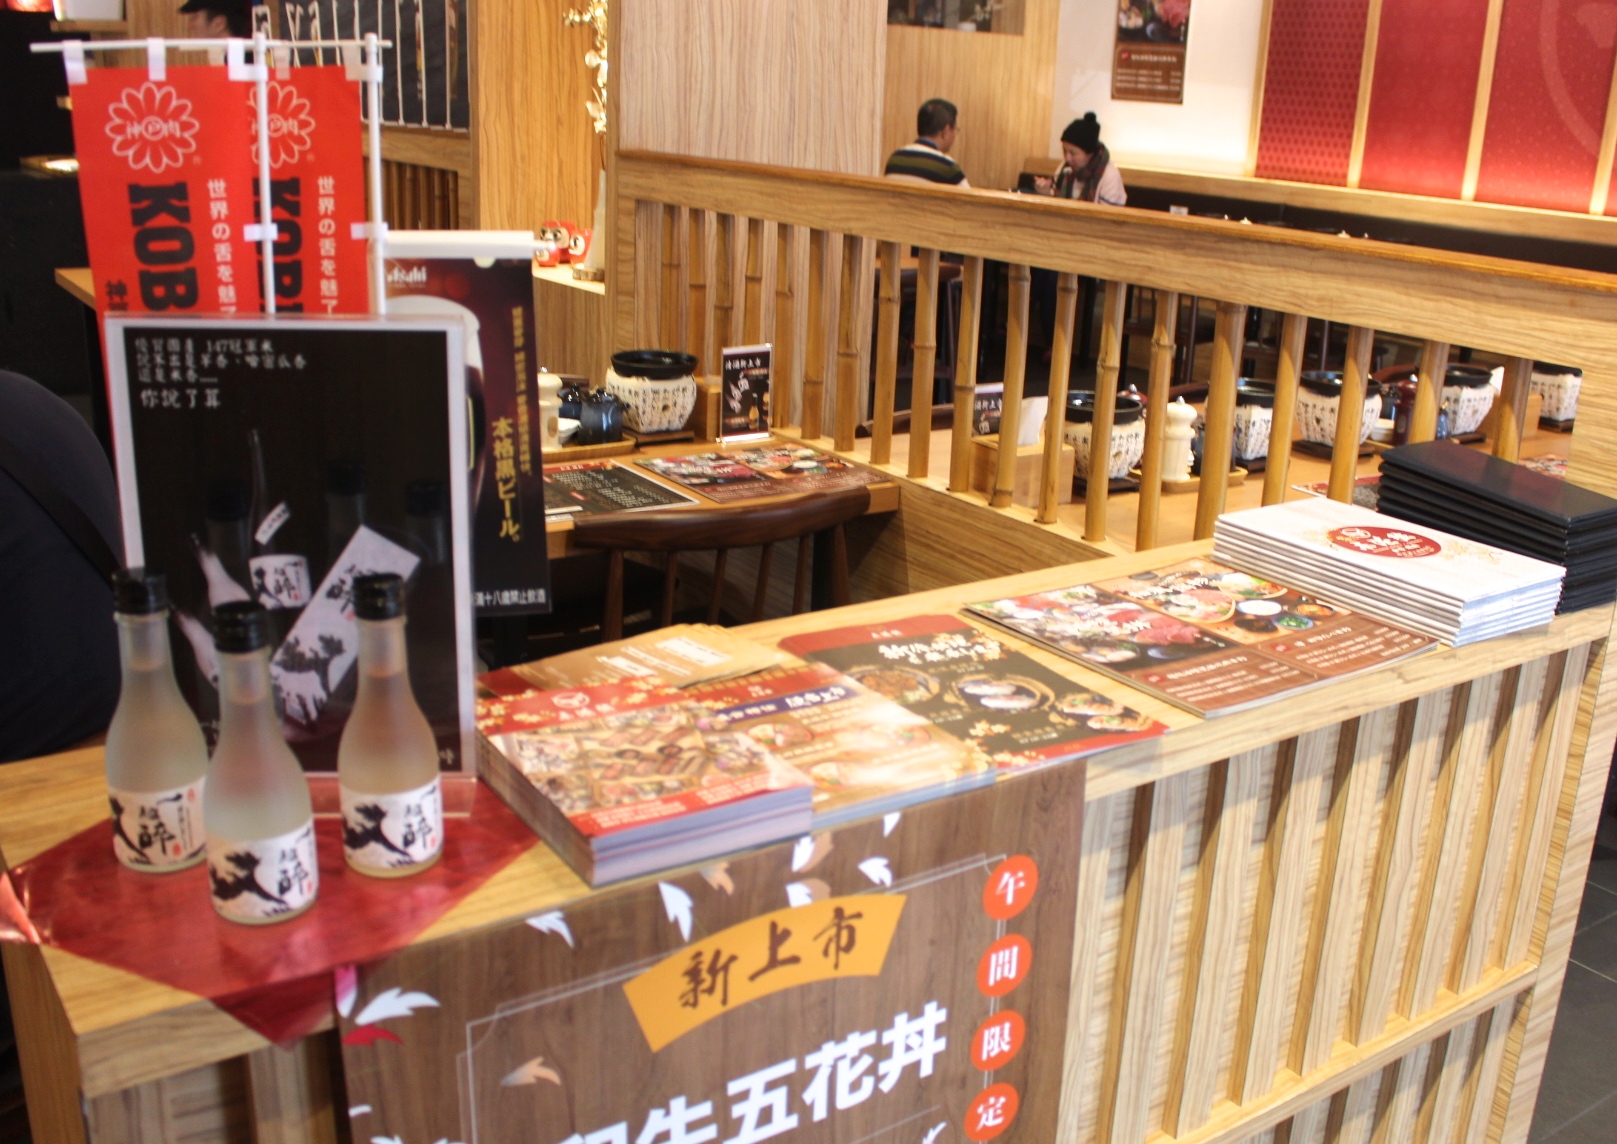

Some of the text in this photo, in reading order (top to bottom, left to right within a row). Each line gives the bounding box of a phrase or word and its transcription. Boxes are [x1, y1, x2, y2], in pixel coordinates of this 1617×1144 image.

[253, 177, 304, 314] KOB
[472, 588, 546, 608] 滿十八歲禁止飲酒
[678, 906, 864, 1010] 新上市
[976, 870, 1026, 1133] 午間限定
